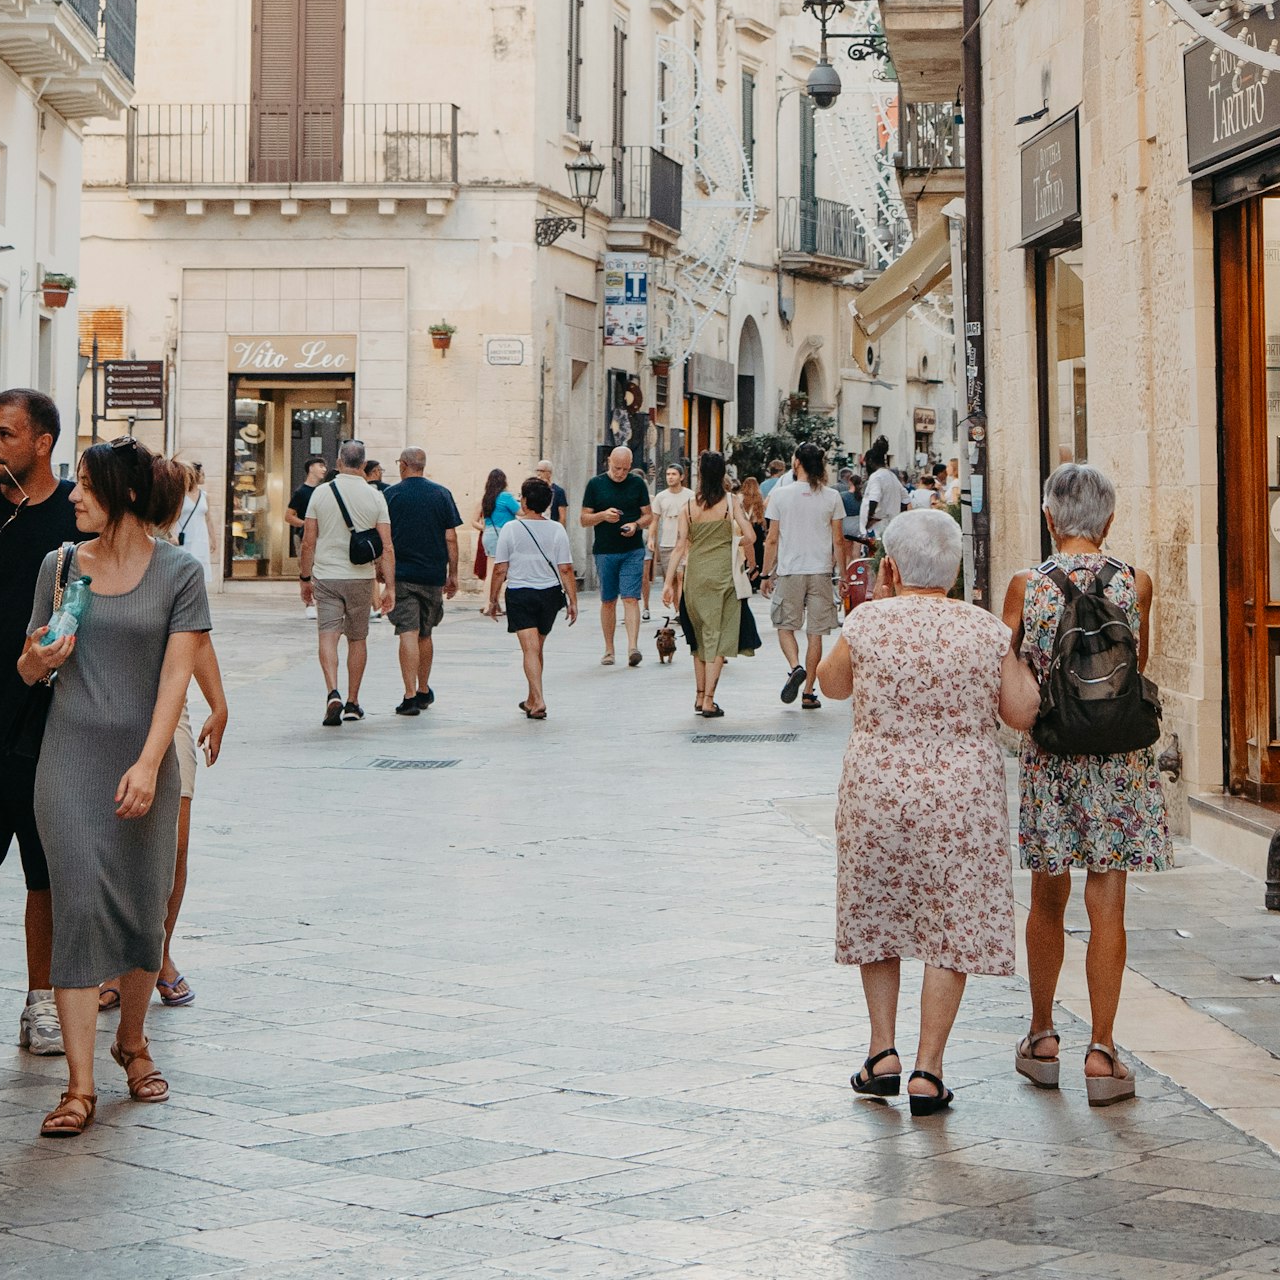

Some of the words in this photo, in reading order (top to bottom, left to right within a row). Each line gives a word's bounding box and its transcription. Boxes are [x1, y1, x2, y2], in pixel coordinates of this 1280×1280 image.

[1208, 81, 1265, 143] TARTUFO
[233, 340, 289, 368] Vito
[293, 340, 349, 368] Leo
